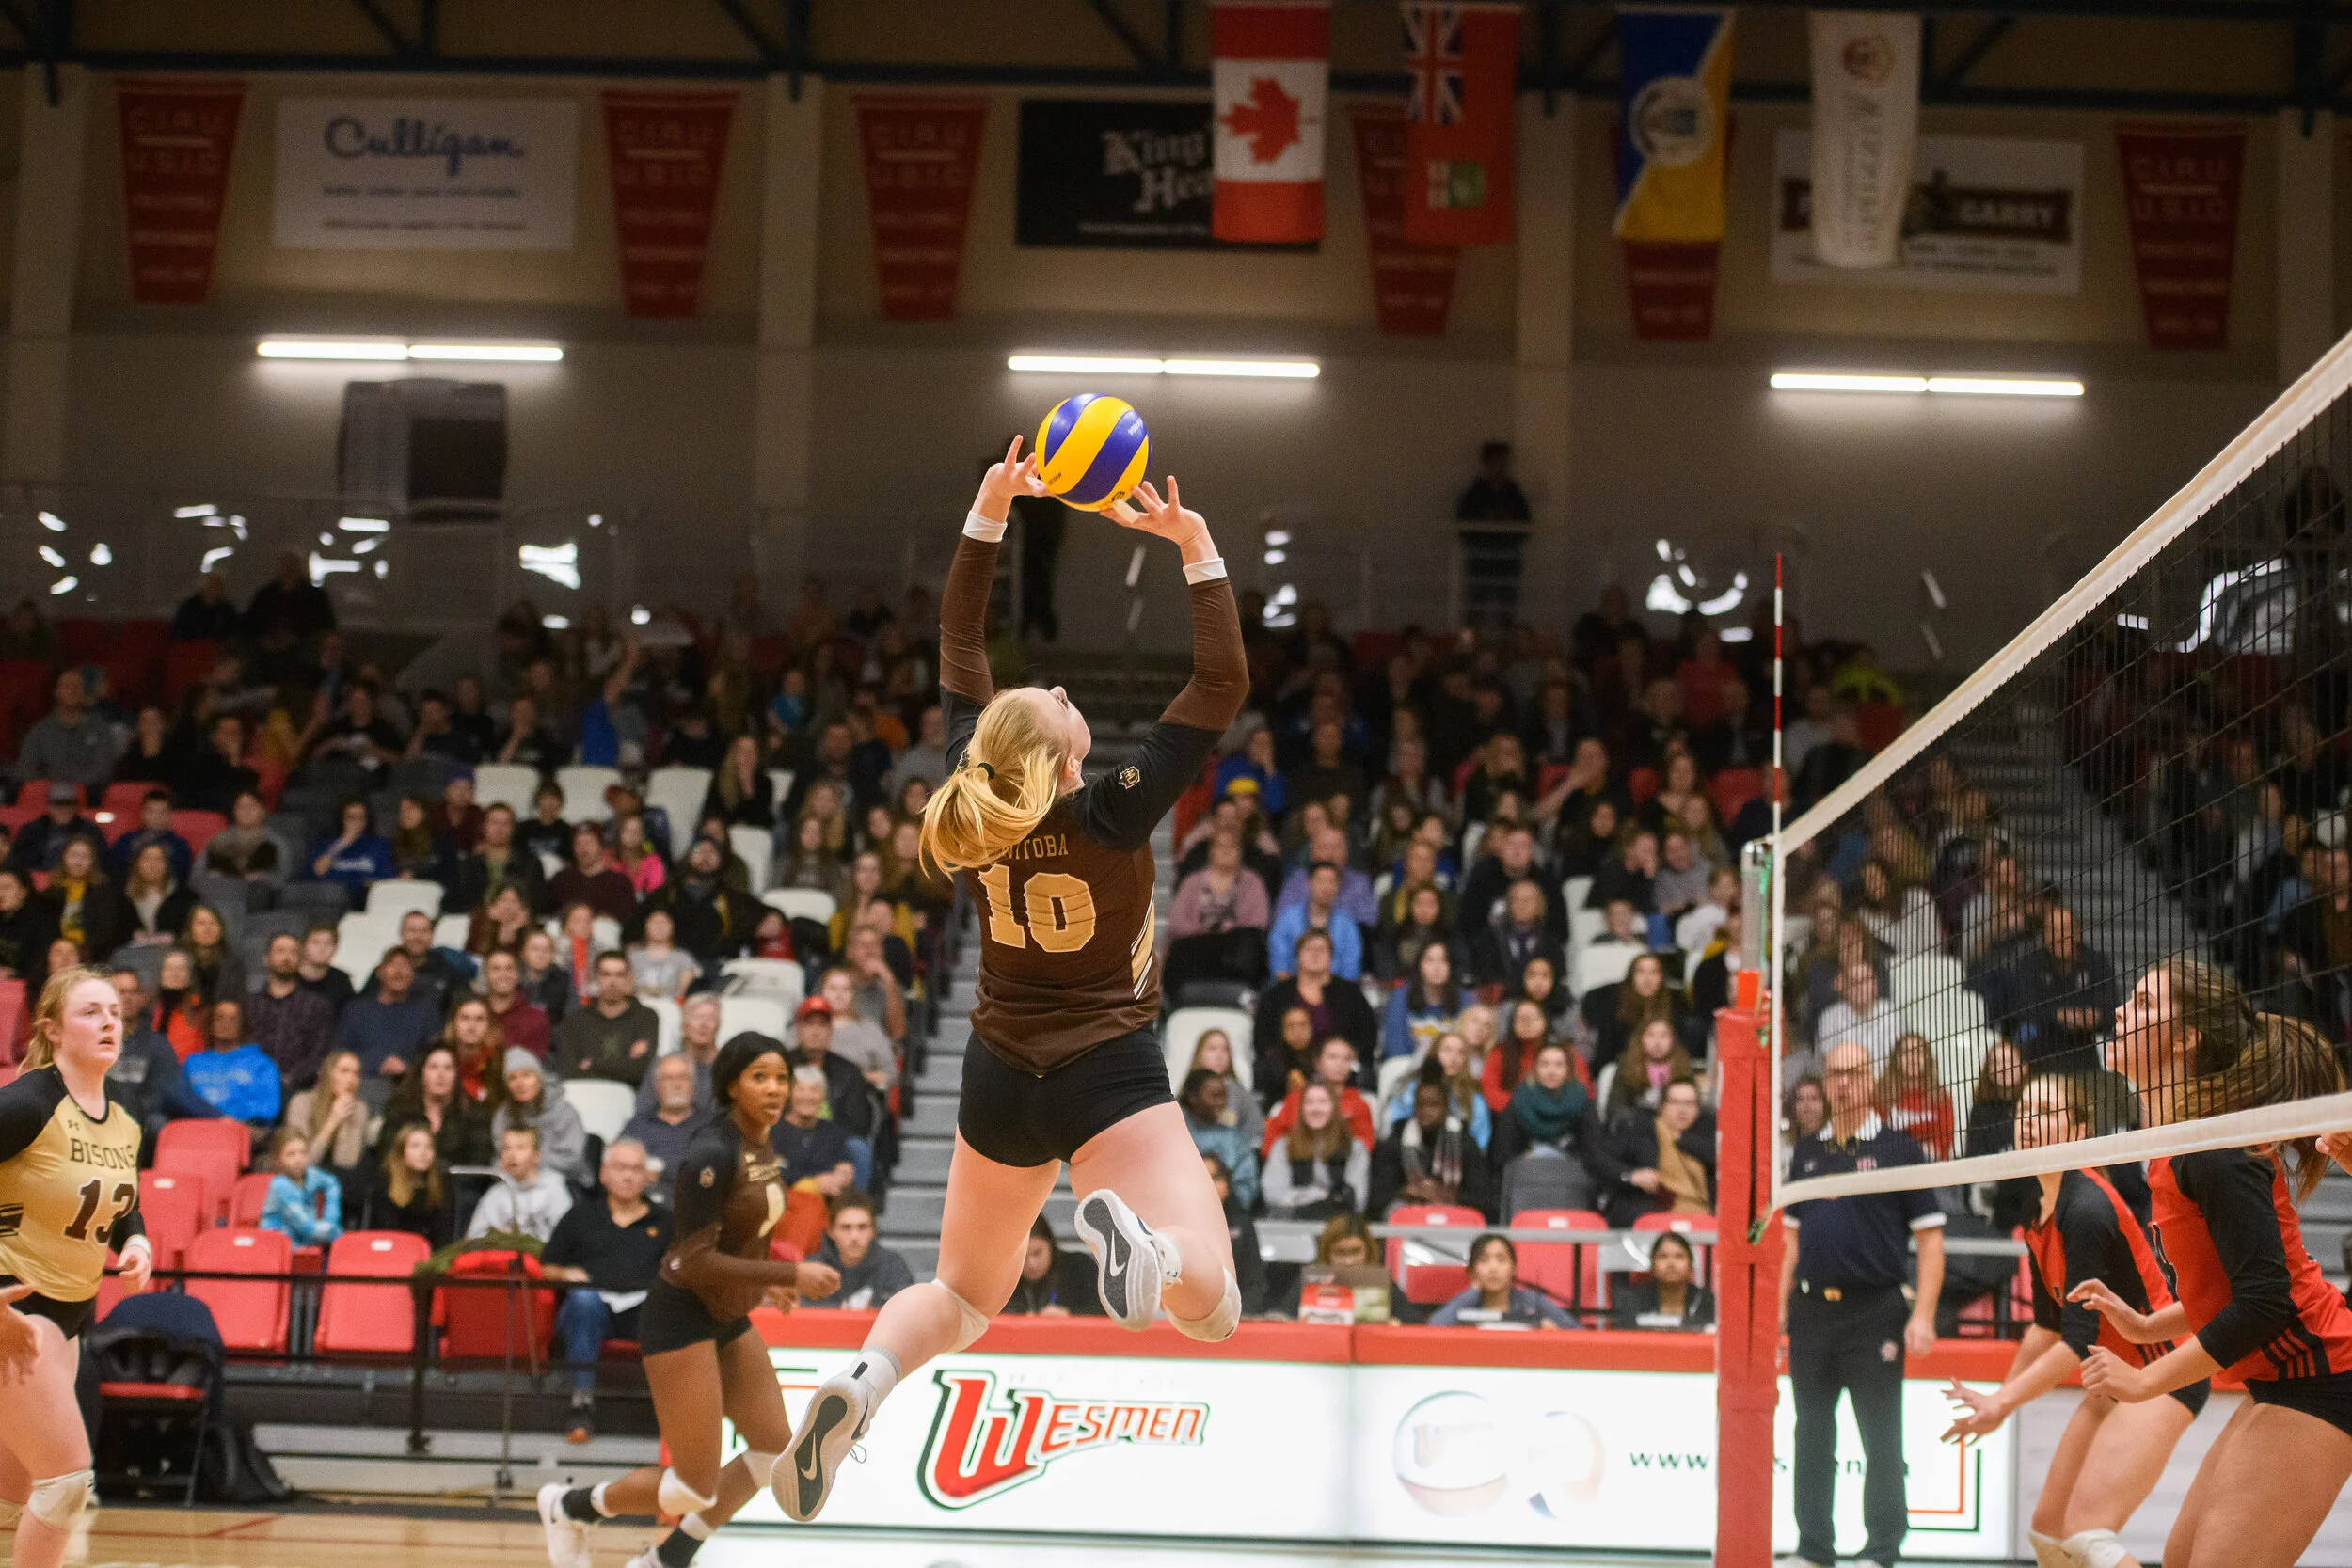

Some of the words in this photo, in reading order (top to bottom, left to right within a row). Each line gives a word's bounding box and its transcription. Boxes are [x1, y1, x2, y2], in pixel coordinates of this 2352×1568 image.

[323, 116, 524, 177] Culligan
[978, 863, 1096, 953] 10
[69, 1137, 135, 1170] BISONS
[64, 1179, 135, 1243] 13
